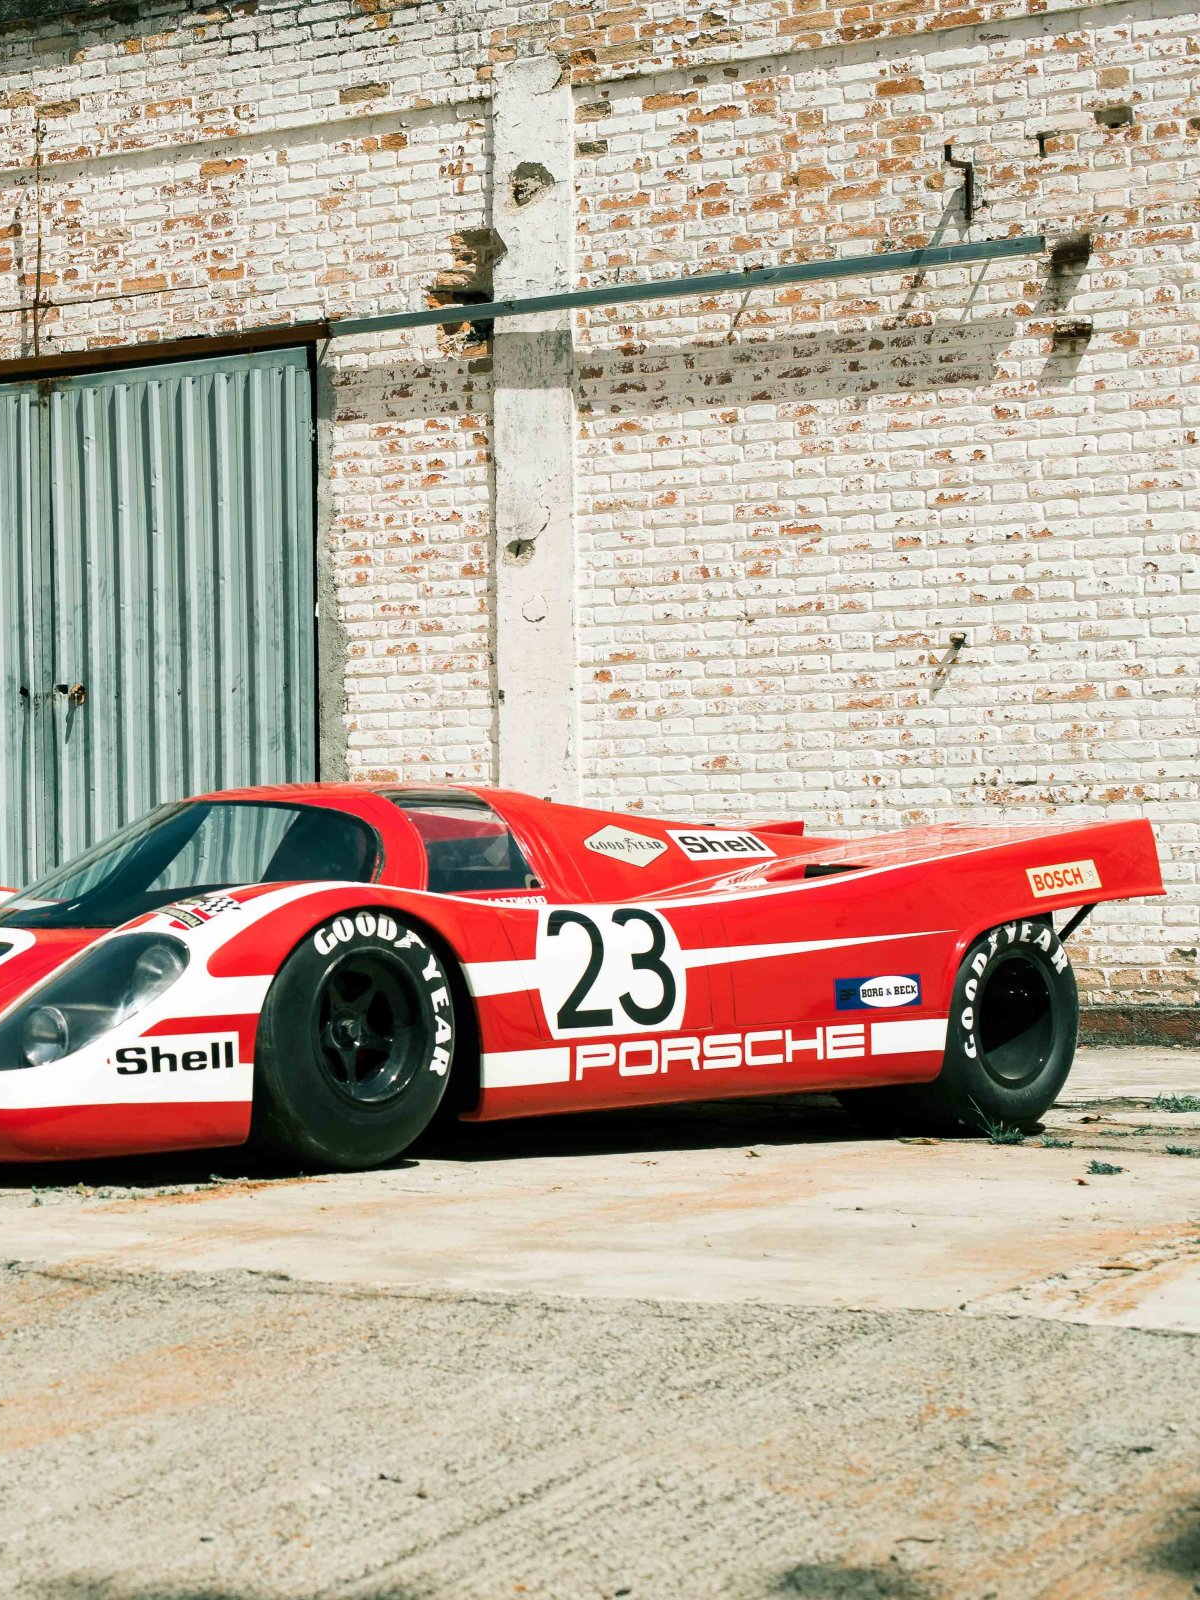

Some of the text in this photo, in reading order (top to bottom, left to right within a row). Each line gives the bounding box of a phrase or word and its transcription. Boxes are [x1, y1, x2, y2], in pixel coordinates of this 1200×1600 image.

[678, 836, 766, 854] Shell
[1032, 867, 1084, 892] BOSCH
[546, 908, 677, 1029] 23
[861, 988, 884, 998] BORG
[886, 988, 892, 996] &
[894, 985, 917, 995] BECK
[115, 1041, 234, 1075] Shell
[575, 1023, 865, 1081] PORSCHE
